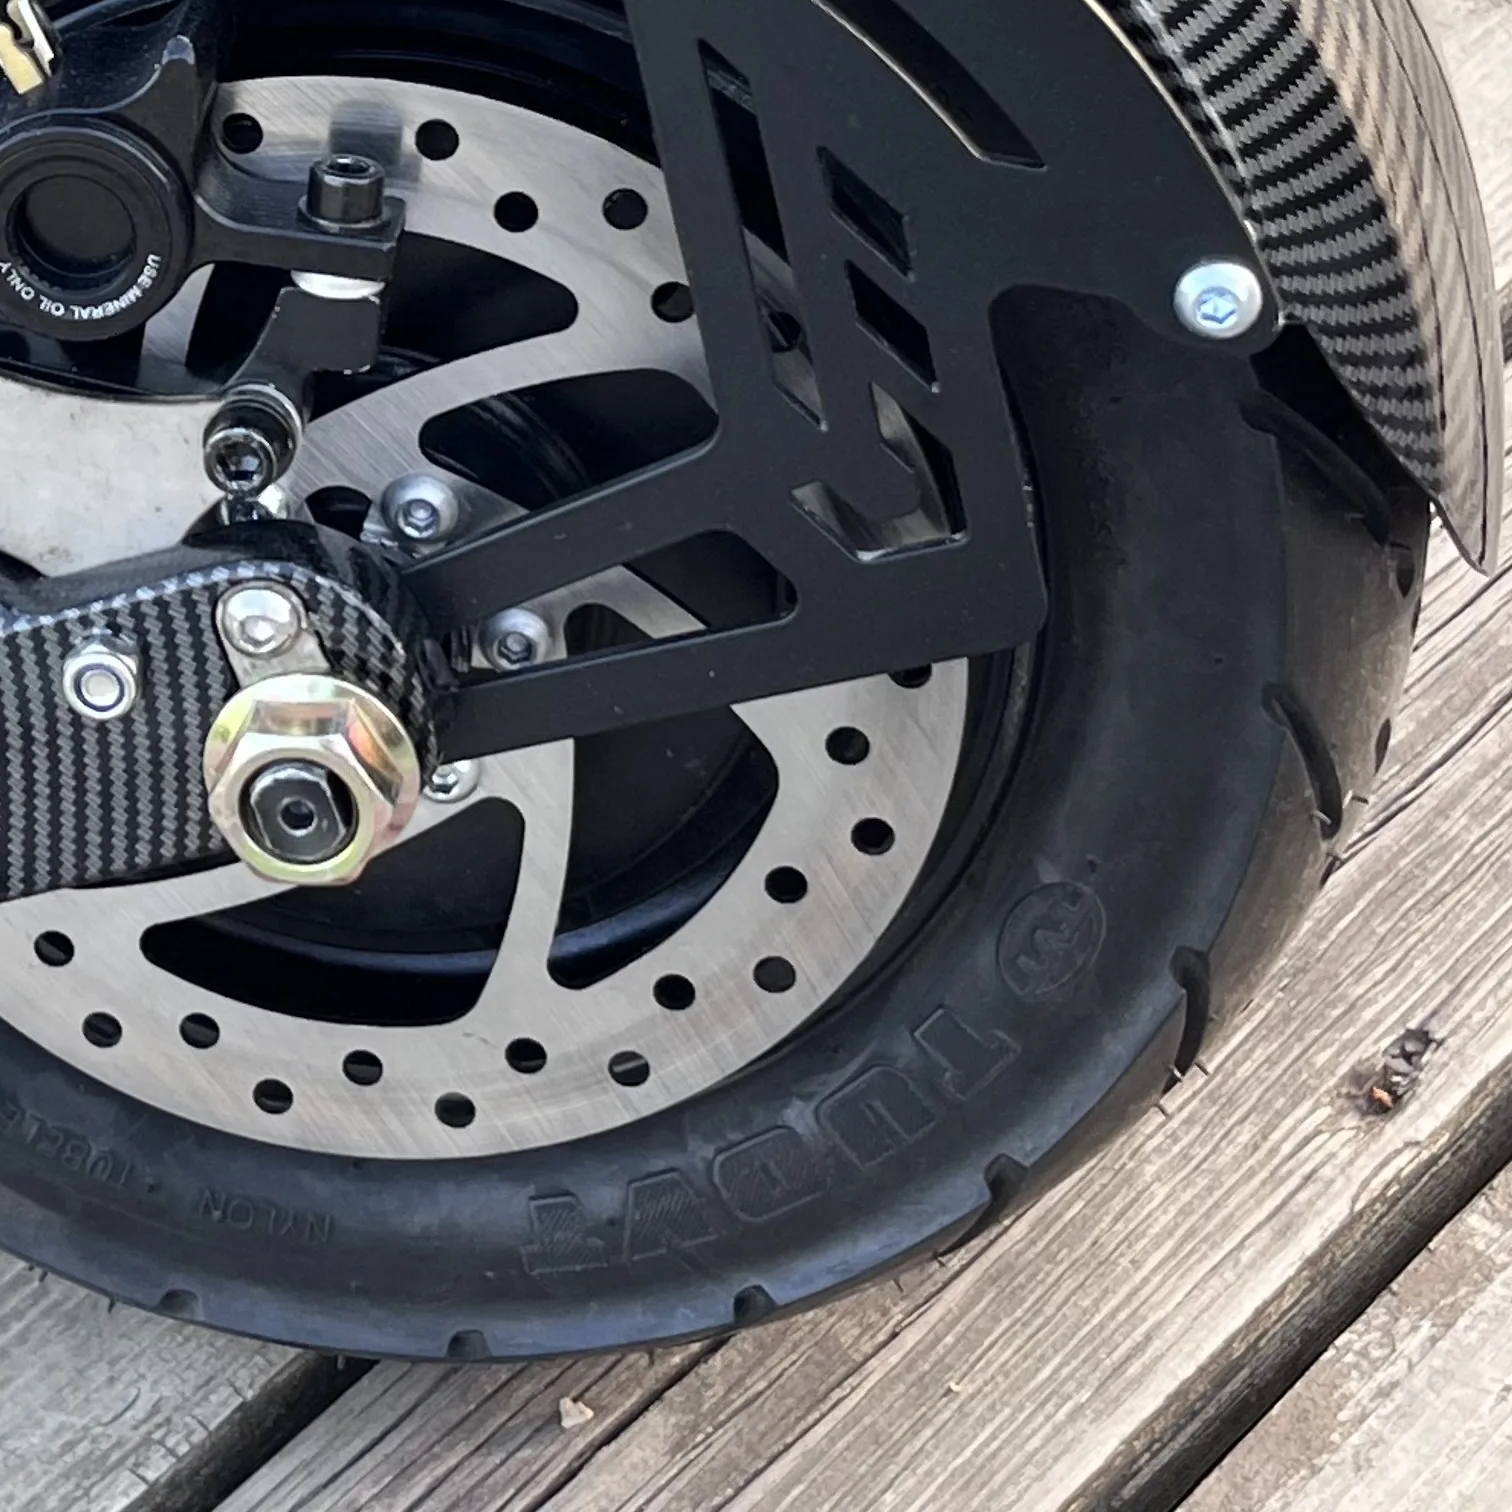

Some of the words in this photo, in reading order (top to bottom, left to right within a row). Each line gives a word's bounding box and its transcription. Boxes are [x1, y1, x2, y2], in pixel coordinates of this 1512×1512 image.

[137, 254, 162, 289] USE
[39, 294, 65, 316] OIL
[70, 285, 143, 319] MINERAL
[198, 1190, 332, 1244] NYLON
